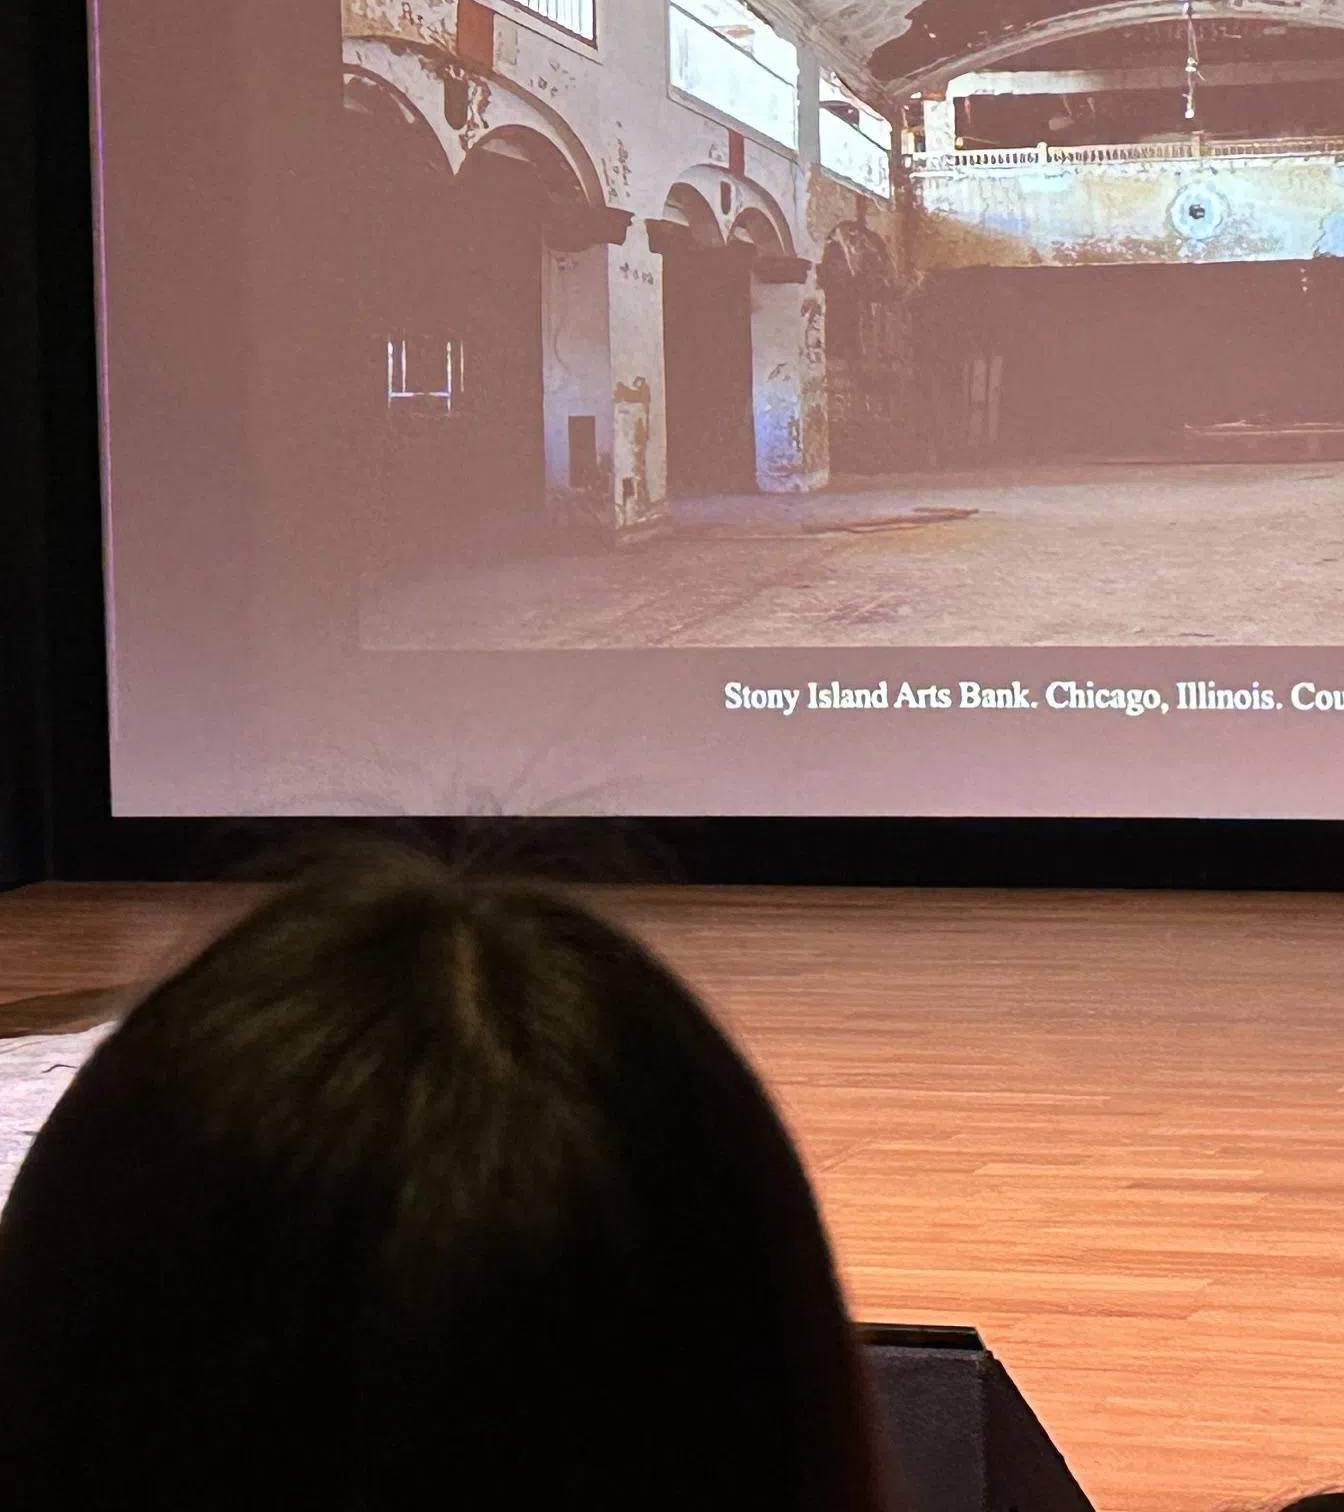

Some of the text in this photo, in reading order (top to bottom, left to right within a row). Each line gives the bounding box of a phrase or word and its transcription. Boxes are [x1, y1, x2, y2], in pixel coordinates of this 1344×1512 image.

[723, 681, 800, 716] Stony
[807, 680, 889, 709] Island
[893, 681, 952, 709] Arts
[958, 680, 1038, 709] Bank.
[1045, 680, 1170, 716] Chicago,
[1175, 680, 1283, 711] Illinois.
